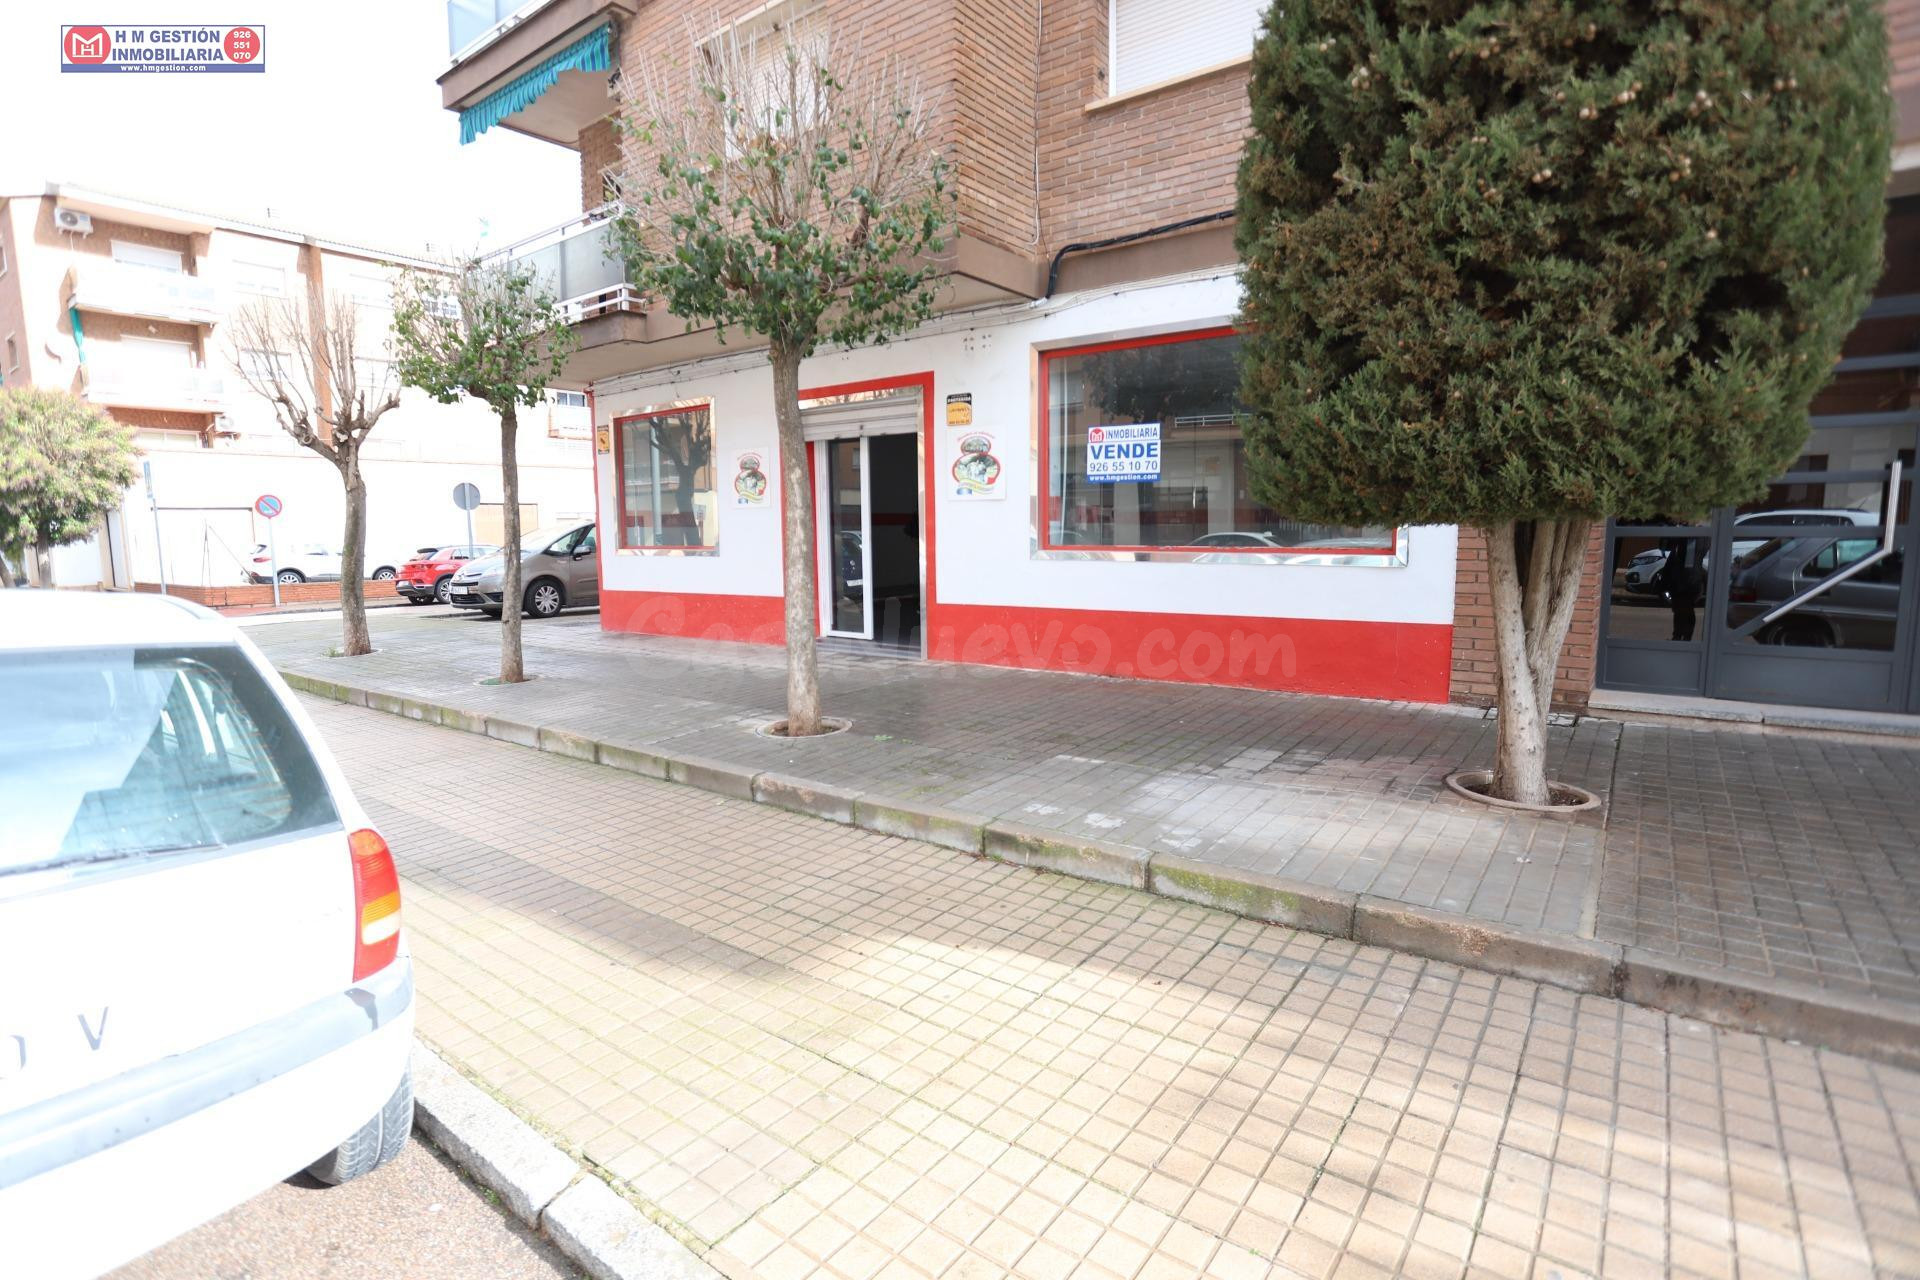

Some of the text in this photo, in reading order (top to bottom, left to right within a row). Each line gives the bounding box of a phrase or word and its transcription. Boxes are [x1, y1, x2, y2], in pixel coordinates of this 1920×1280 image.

[1105, 427, 1158, 440] INMOBILIARIA
[1090, 442, 1158, 460] VENDE
[1089, 460, 1158, 472] 926 55 10 70
[1089, 474, 1158, 482] www.hmgestion.com
